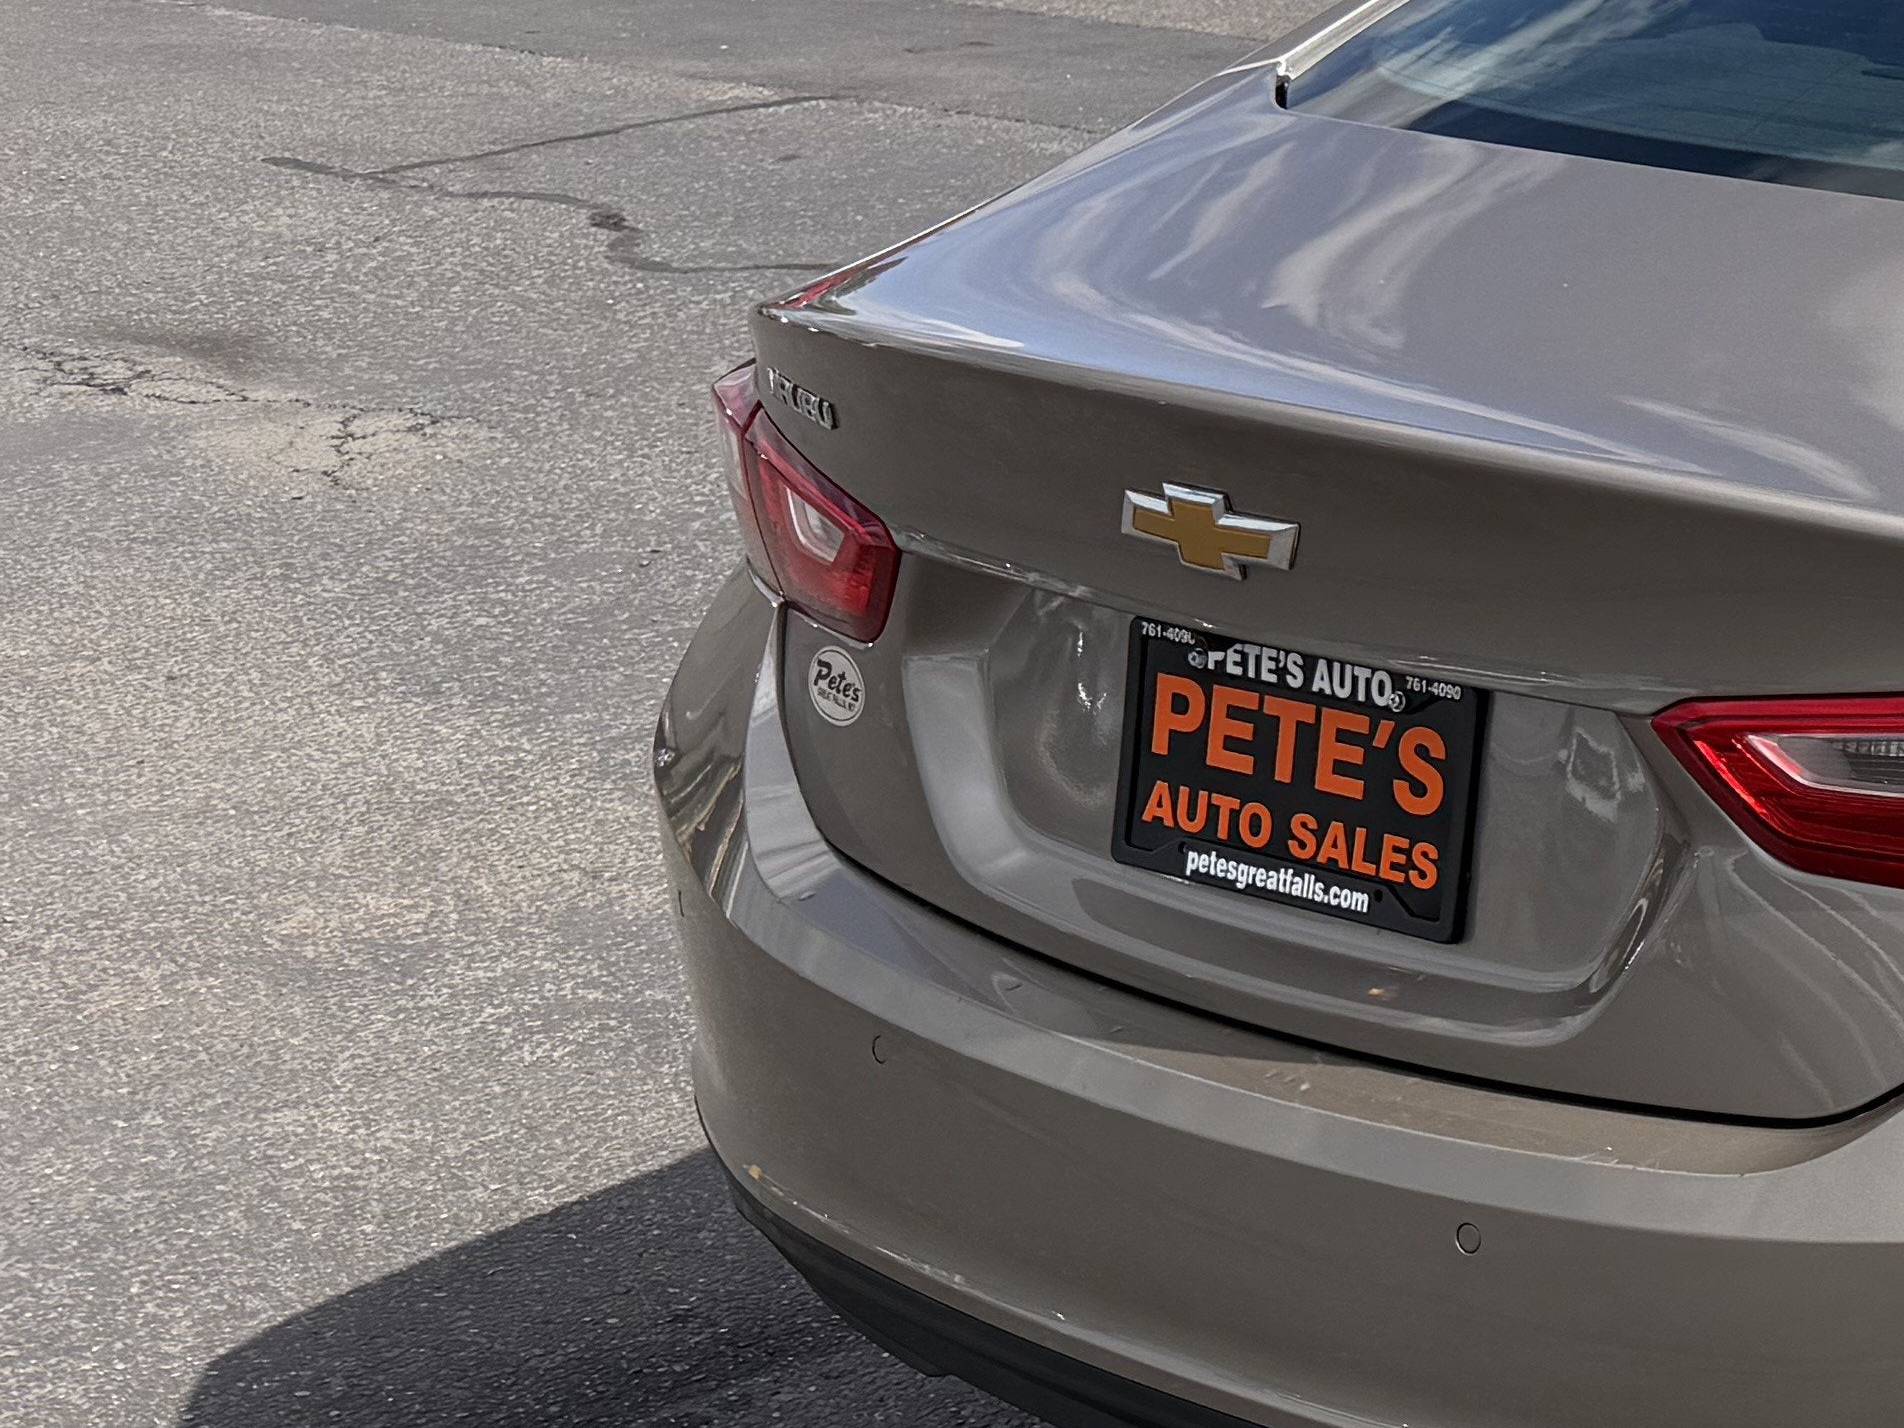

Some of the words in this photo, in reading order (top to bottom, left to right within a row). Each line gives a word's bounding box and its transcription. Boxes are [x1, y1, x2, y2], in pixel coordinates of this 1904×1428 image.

[1311, 658, 1392, 707] AUTO
[1152, 673, 1446, 817] PETE'S
[1142, 780, 1273, 850] AUTO
[1287, 812, 1440, 891] SALES
[1185, 847, 1370, 914] petesgreatfalls.com
